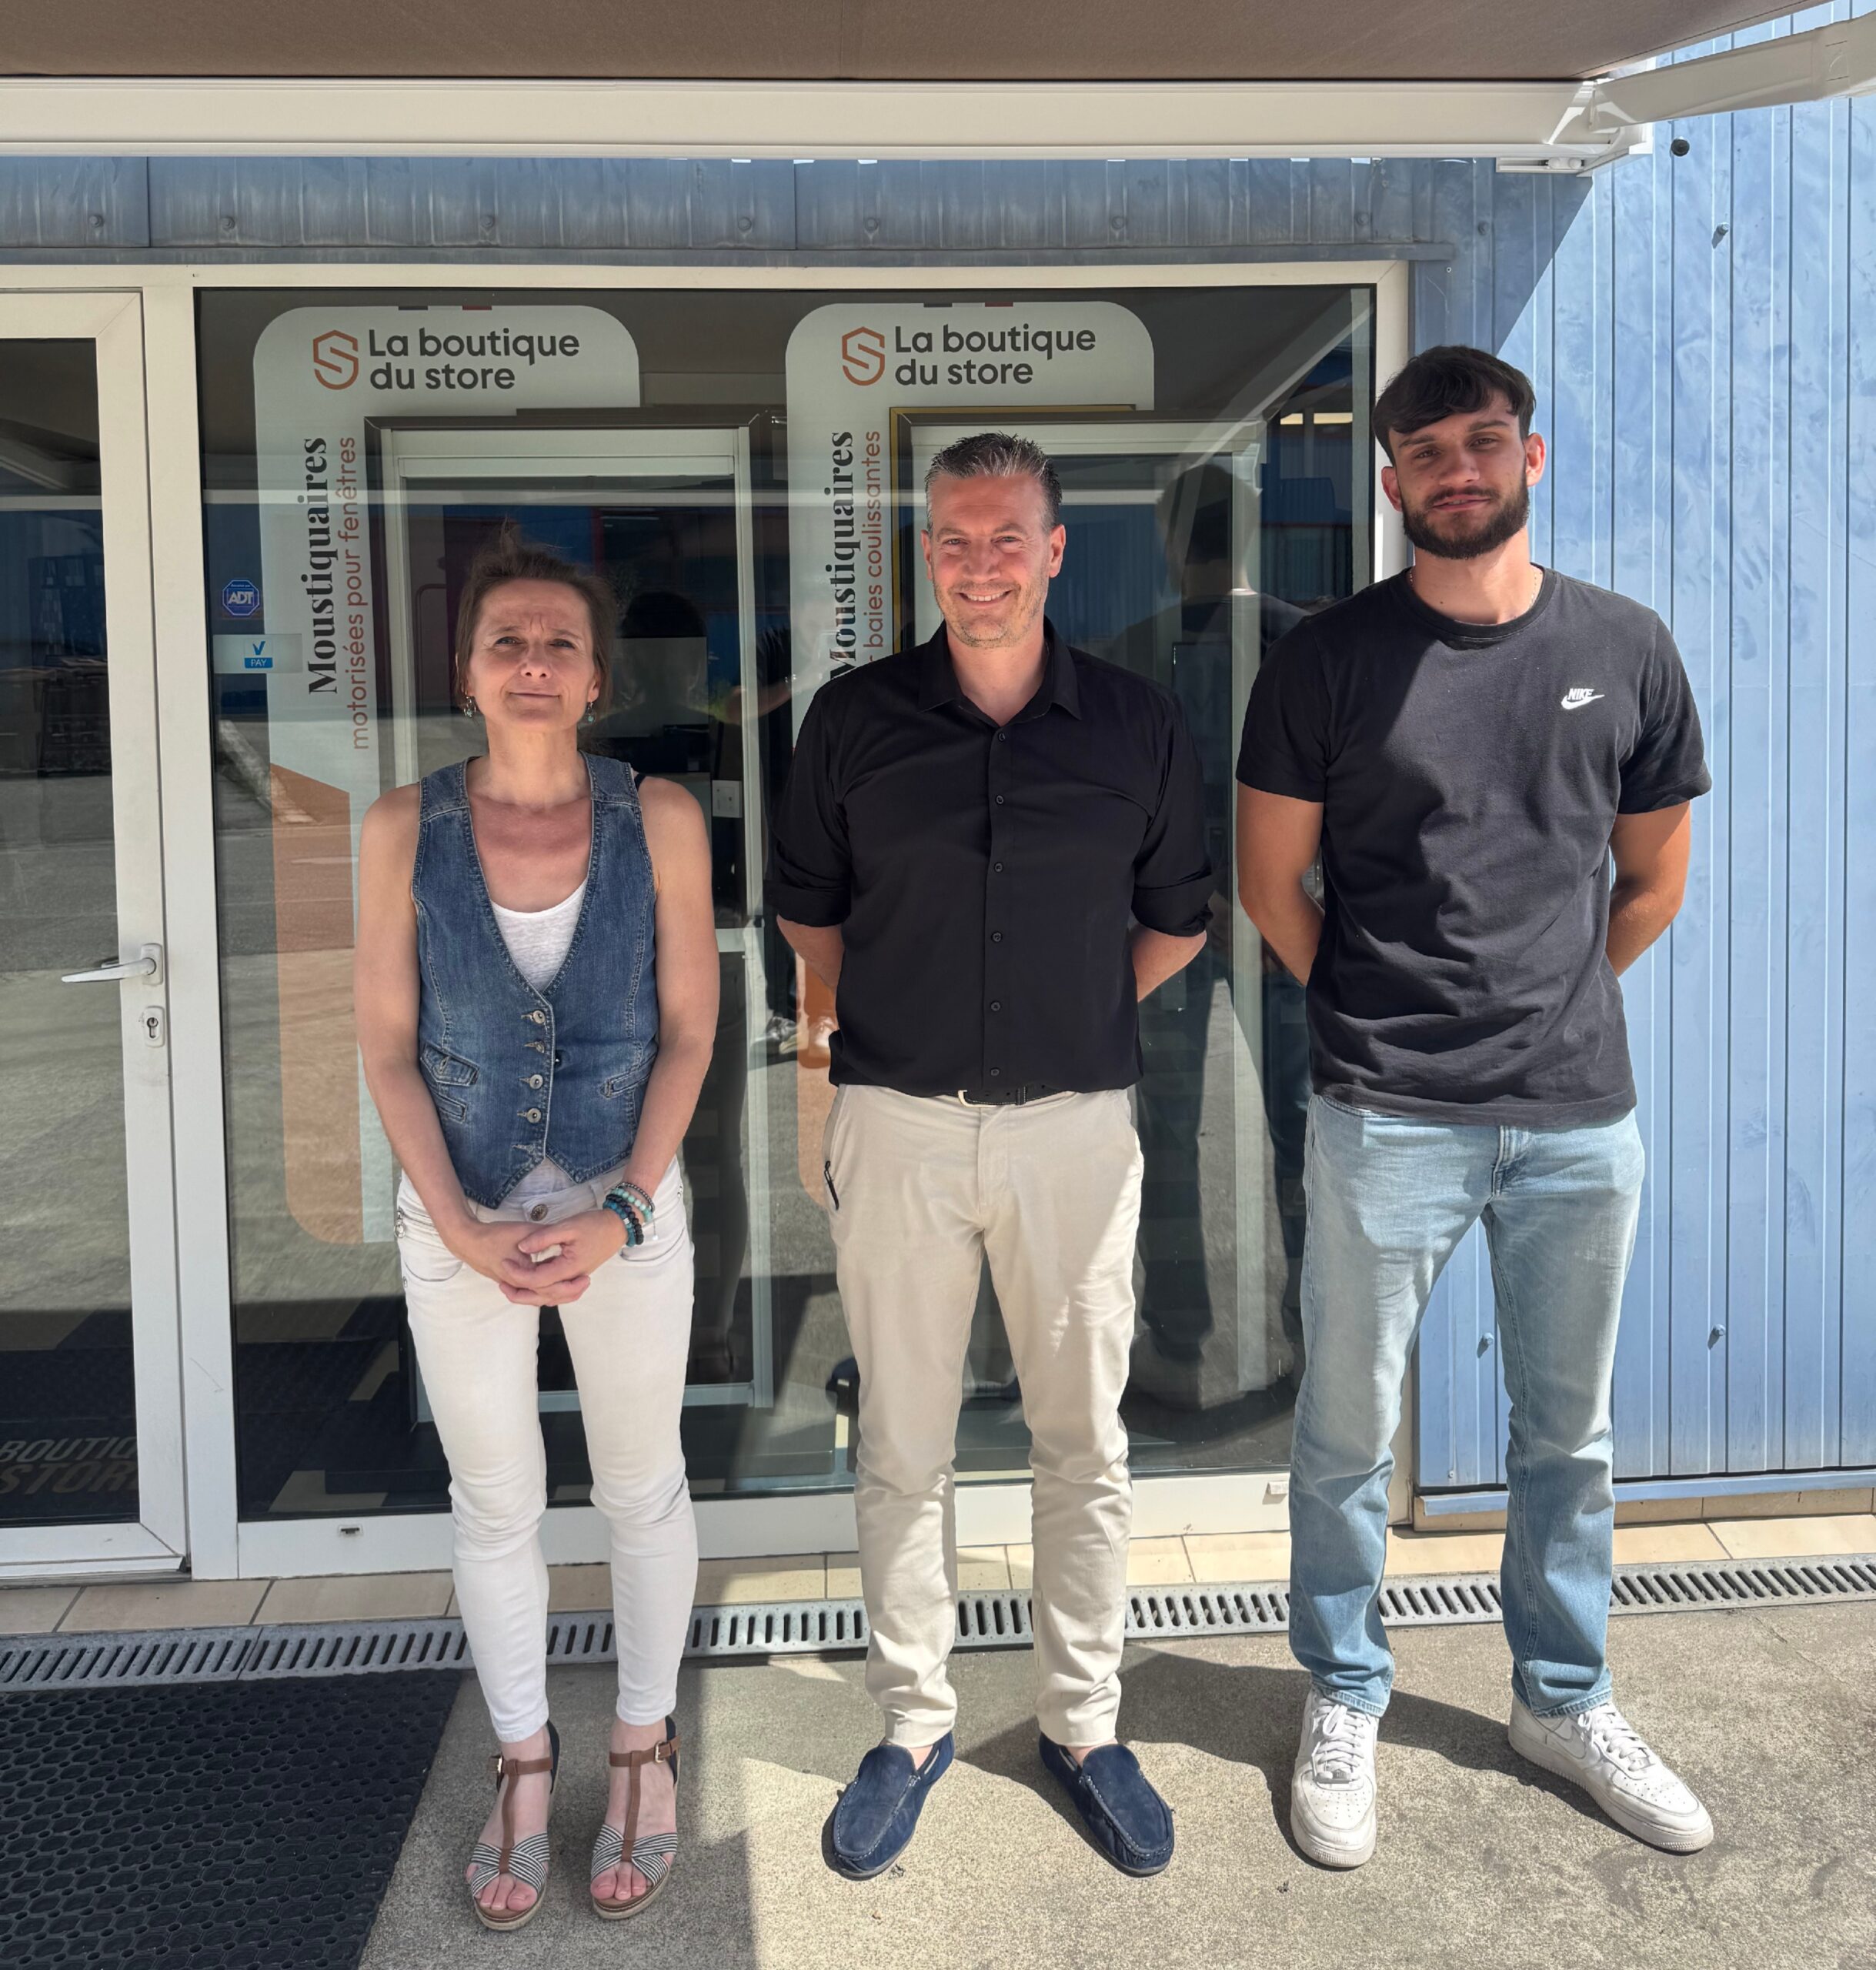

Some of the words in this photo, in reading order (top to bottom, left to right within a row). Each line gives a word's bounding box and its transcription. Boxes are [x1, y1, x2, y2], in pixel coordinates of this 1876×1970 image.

[369, 329, 408, 356] La
[419, 328, 579, 365] boutique
[895, 326, 932, 353] La
[943, 324, 1096, 359] boutique
[370, 362, 415, 389] du
[426, 364, 515, 389] store
[895, 359, 936, 386] du
[947, 360, 1033, 385] store
[335, 437, 359, 541] fenêtres
[861, 431, 883, 577] coulissantes
[298, 437, 339, 694] Moustiquaires
[345, 549, 368, 606] pour
[824, 432, 862, 679] Moustiquaires
[228, 591, 253, 604] ADT
[863, 586, 883, 646] baies
[342, 613, 368, 750] motorisées
[1567, 688, 1594, 700] NIKE
[0, 1461, 138, 1494] STOR
